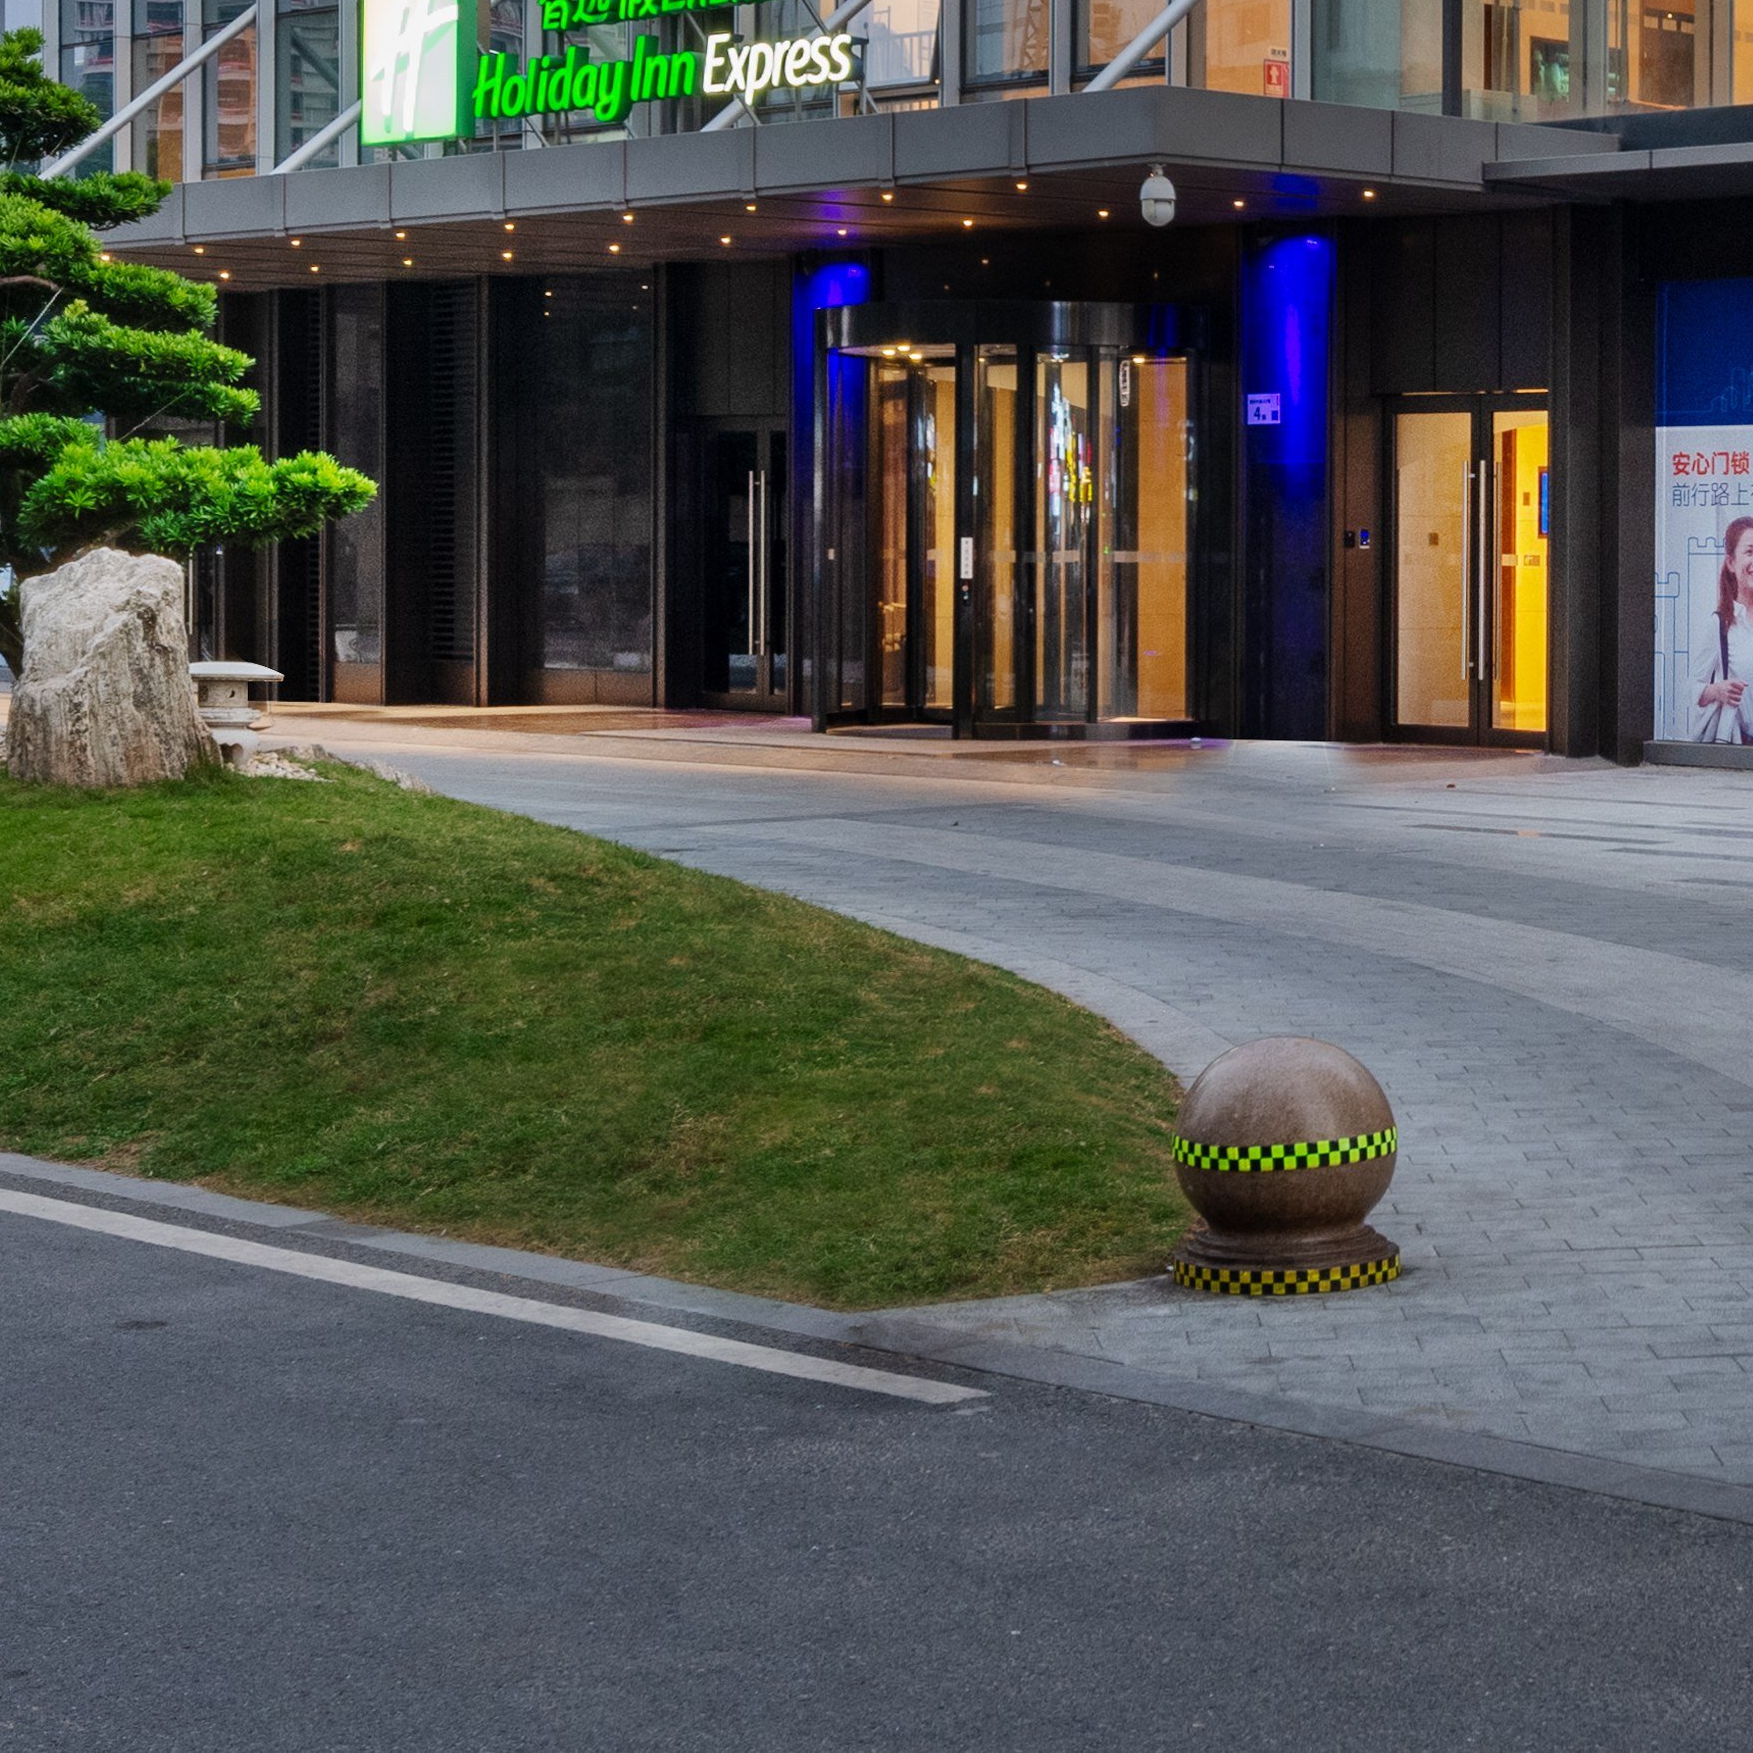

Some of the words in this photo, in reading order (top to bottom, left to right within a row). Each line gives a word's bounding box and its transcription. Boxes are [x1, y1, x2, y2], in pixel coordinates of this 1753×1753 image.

[473, 44, 629, 123] Holiday
[630, 35, 696, 101] Inn
[702, 31, 854, 106] Express
